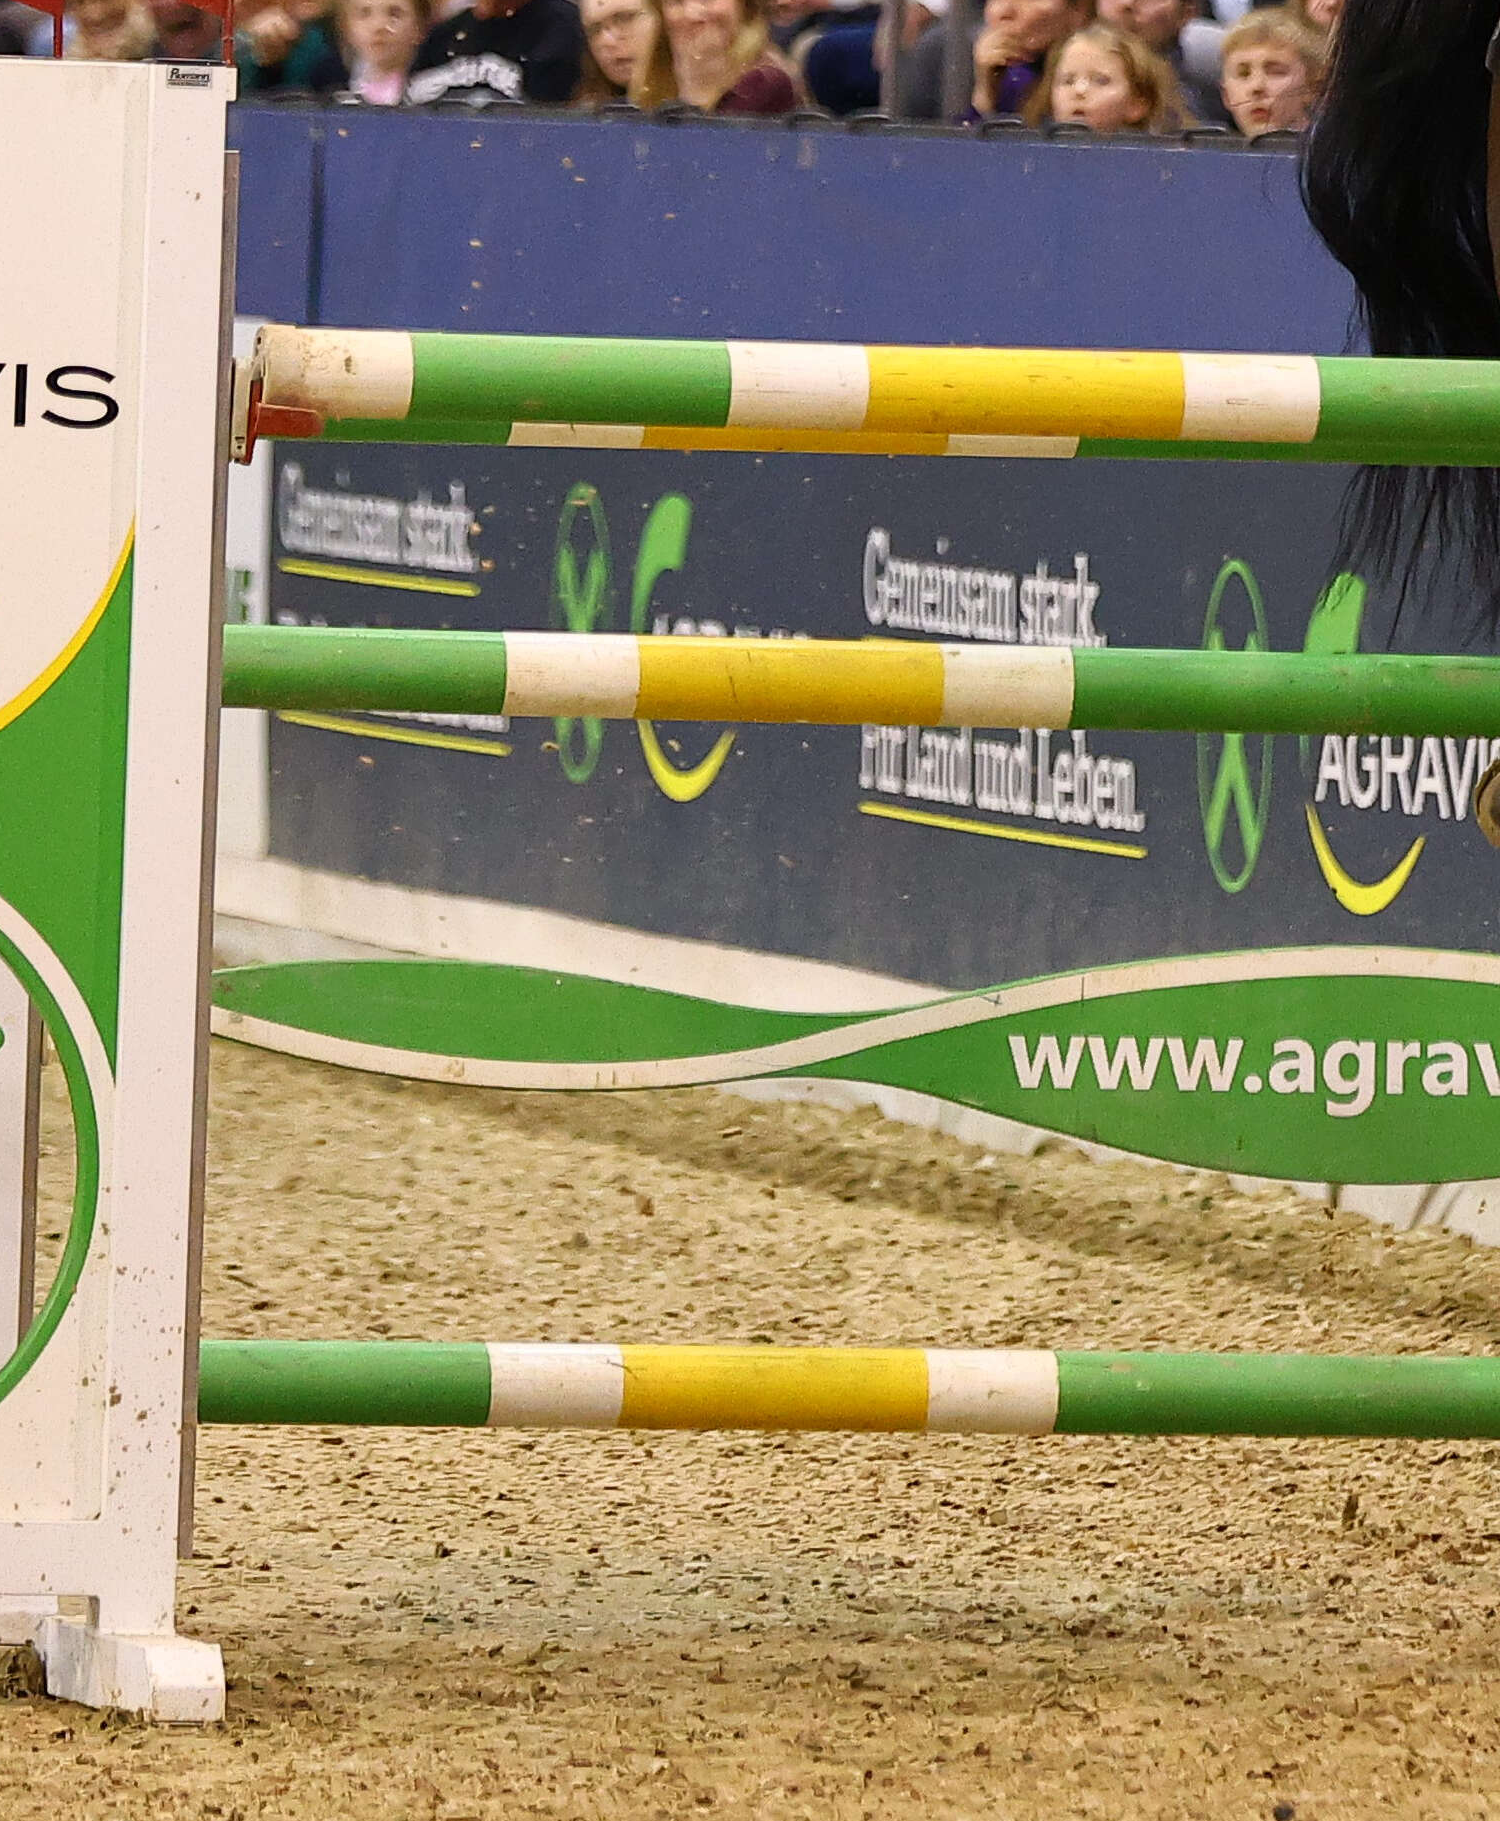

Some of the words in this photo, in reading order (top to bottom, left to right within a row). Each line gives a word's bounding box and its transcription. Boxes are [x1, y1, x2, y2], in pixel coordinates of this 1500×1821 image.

[862, 526, 1018, 644] Gemeinsam
[1018, 551, 1108, 649] stark.
[1033, 729, 1146, 833] Leben.
